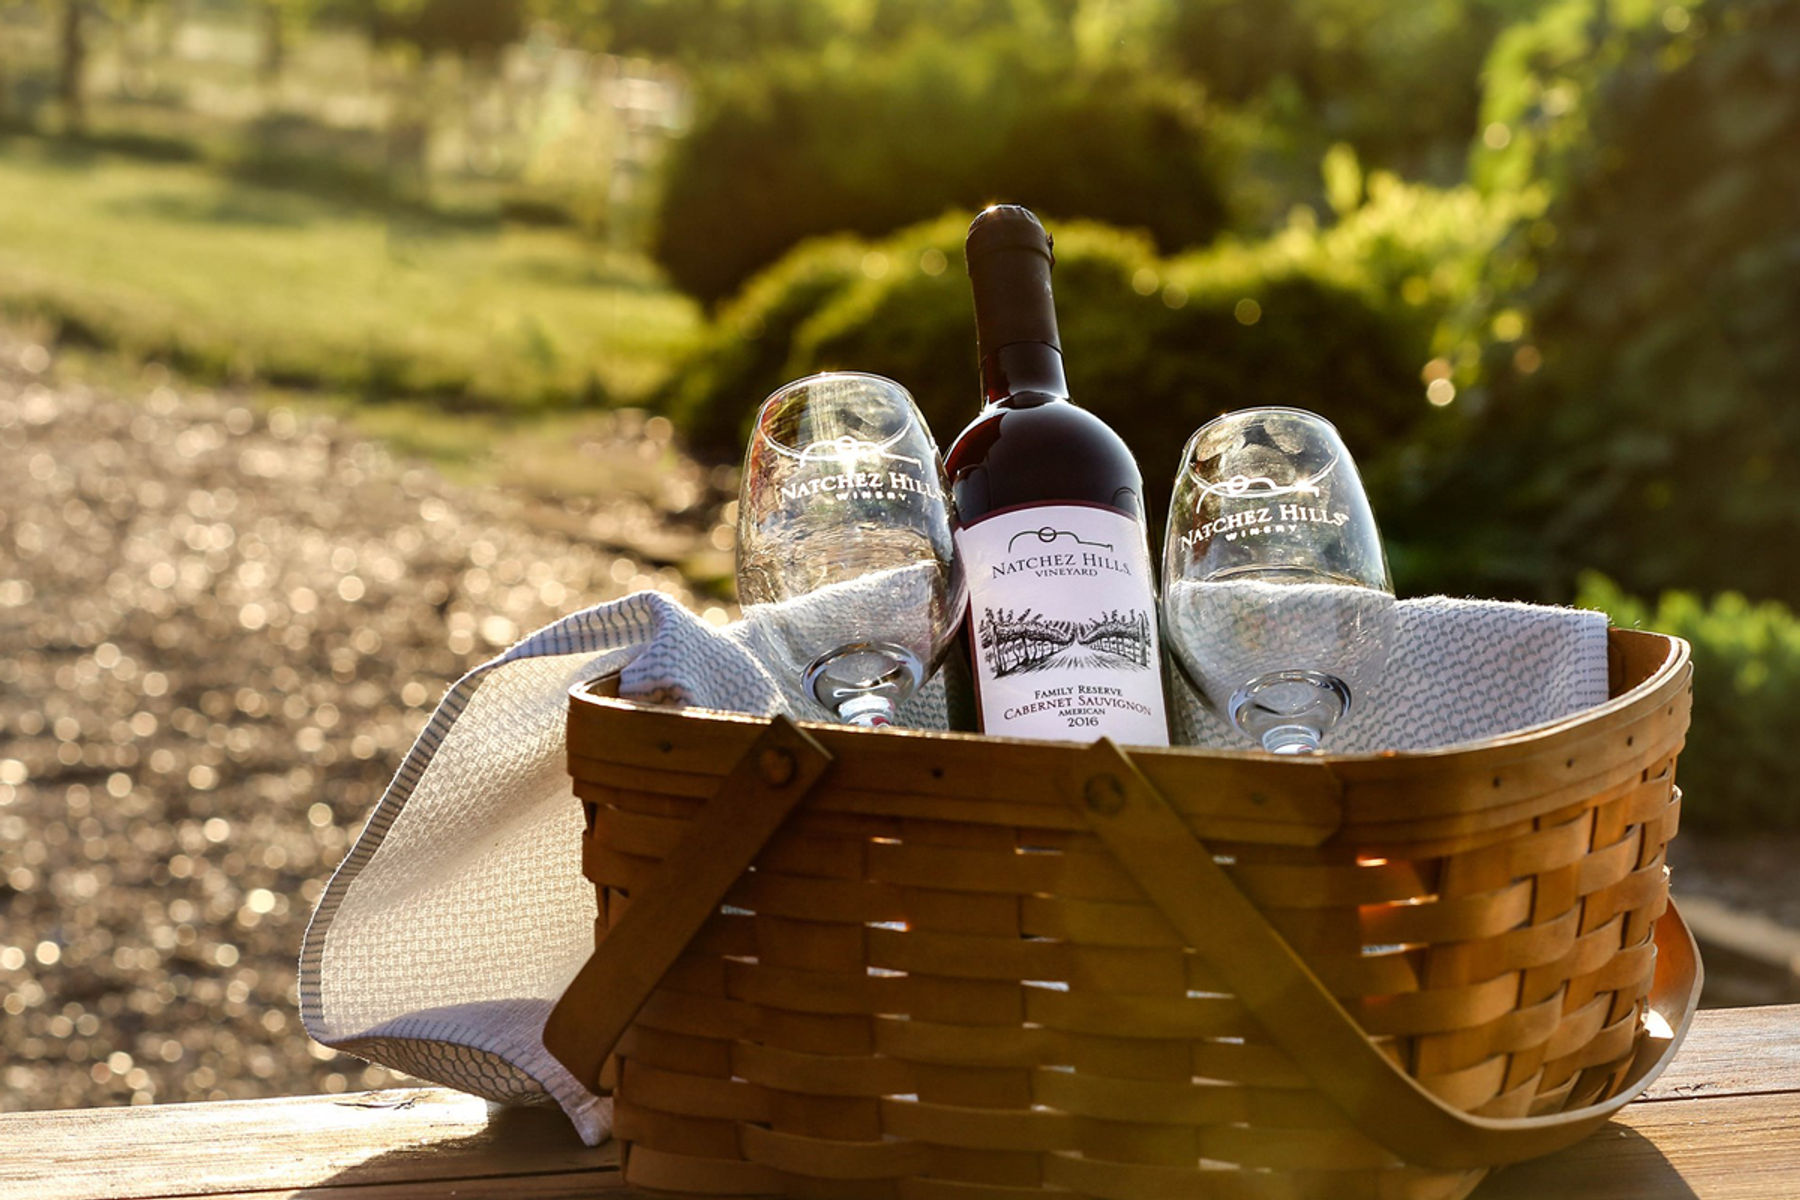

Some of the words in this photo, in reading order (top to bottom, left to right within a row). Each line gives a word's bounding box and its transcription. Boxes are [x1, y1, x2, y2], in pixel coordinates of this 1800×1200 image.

[780, 472, 883, 503] NATCHEZ
[1180, 507, 1273, 552] NATCHEZ
[1279, 504, 1350, 527] HILLS
[992, 554, 1076, 579] NATCHEZ
[1083, 553, 1132, 576] HILLS
[1035, 568, 1098, 578] VINEYARD
[1034, 685, 1074, 699] FAMILY
[1078, 685, 1123, 697] RESERVE
[1004, 697, 1072, 721] CABERNET
[1078, 695, 1151, 716] SAUVIGNON
[1058, 708, 1106, 717] AMERICAN
[1068, 717, 1099, 728] 2016
